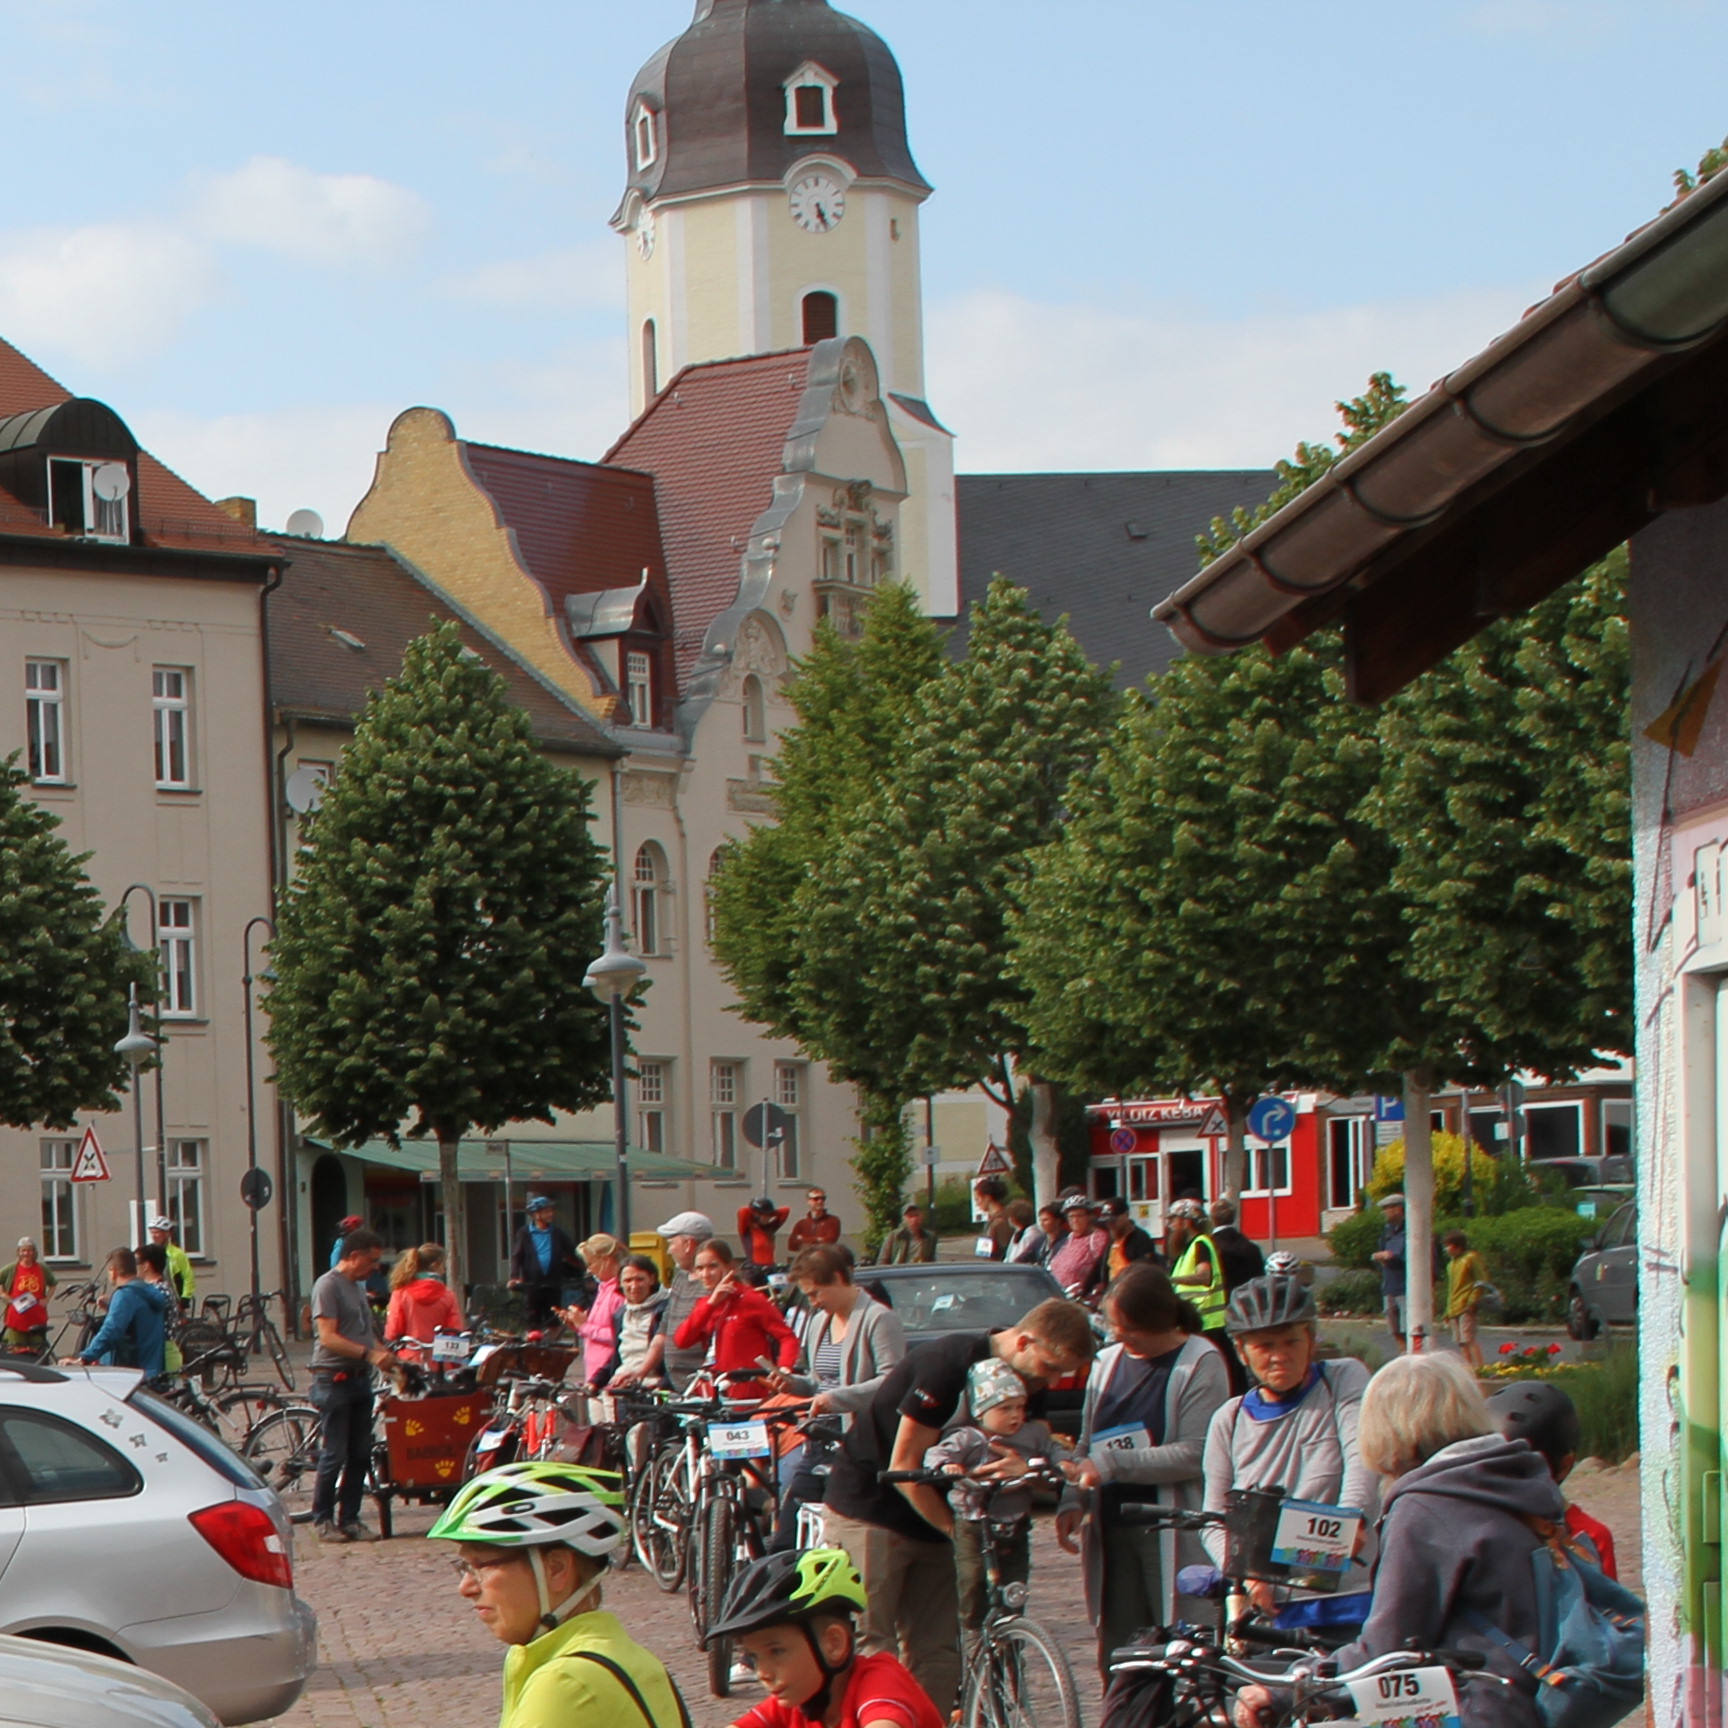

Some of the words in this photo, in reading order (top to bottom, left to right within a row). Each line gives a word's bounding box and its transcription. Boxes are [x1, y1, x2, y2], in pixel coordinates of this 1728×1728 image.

[1161, 1104, 1208, 1119] KEBA
[726, 1430, 750, 1441] 043
[1308, 1517, 1342, 1538] 102
[1378, 1673, 1420, 1699] 075
